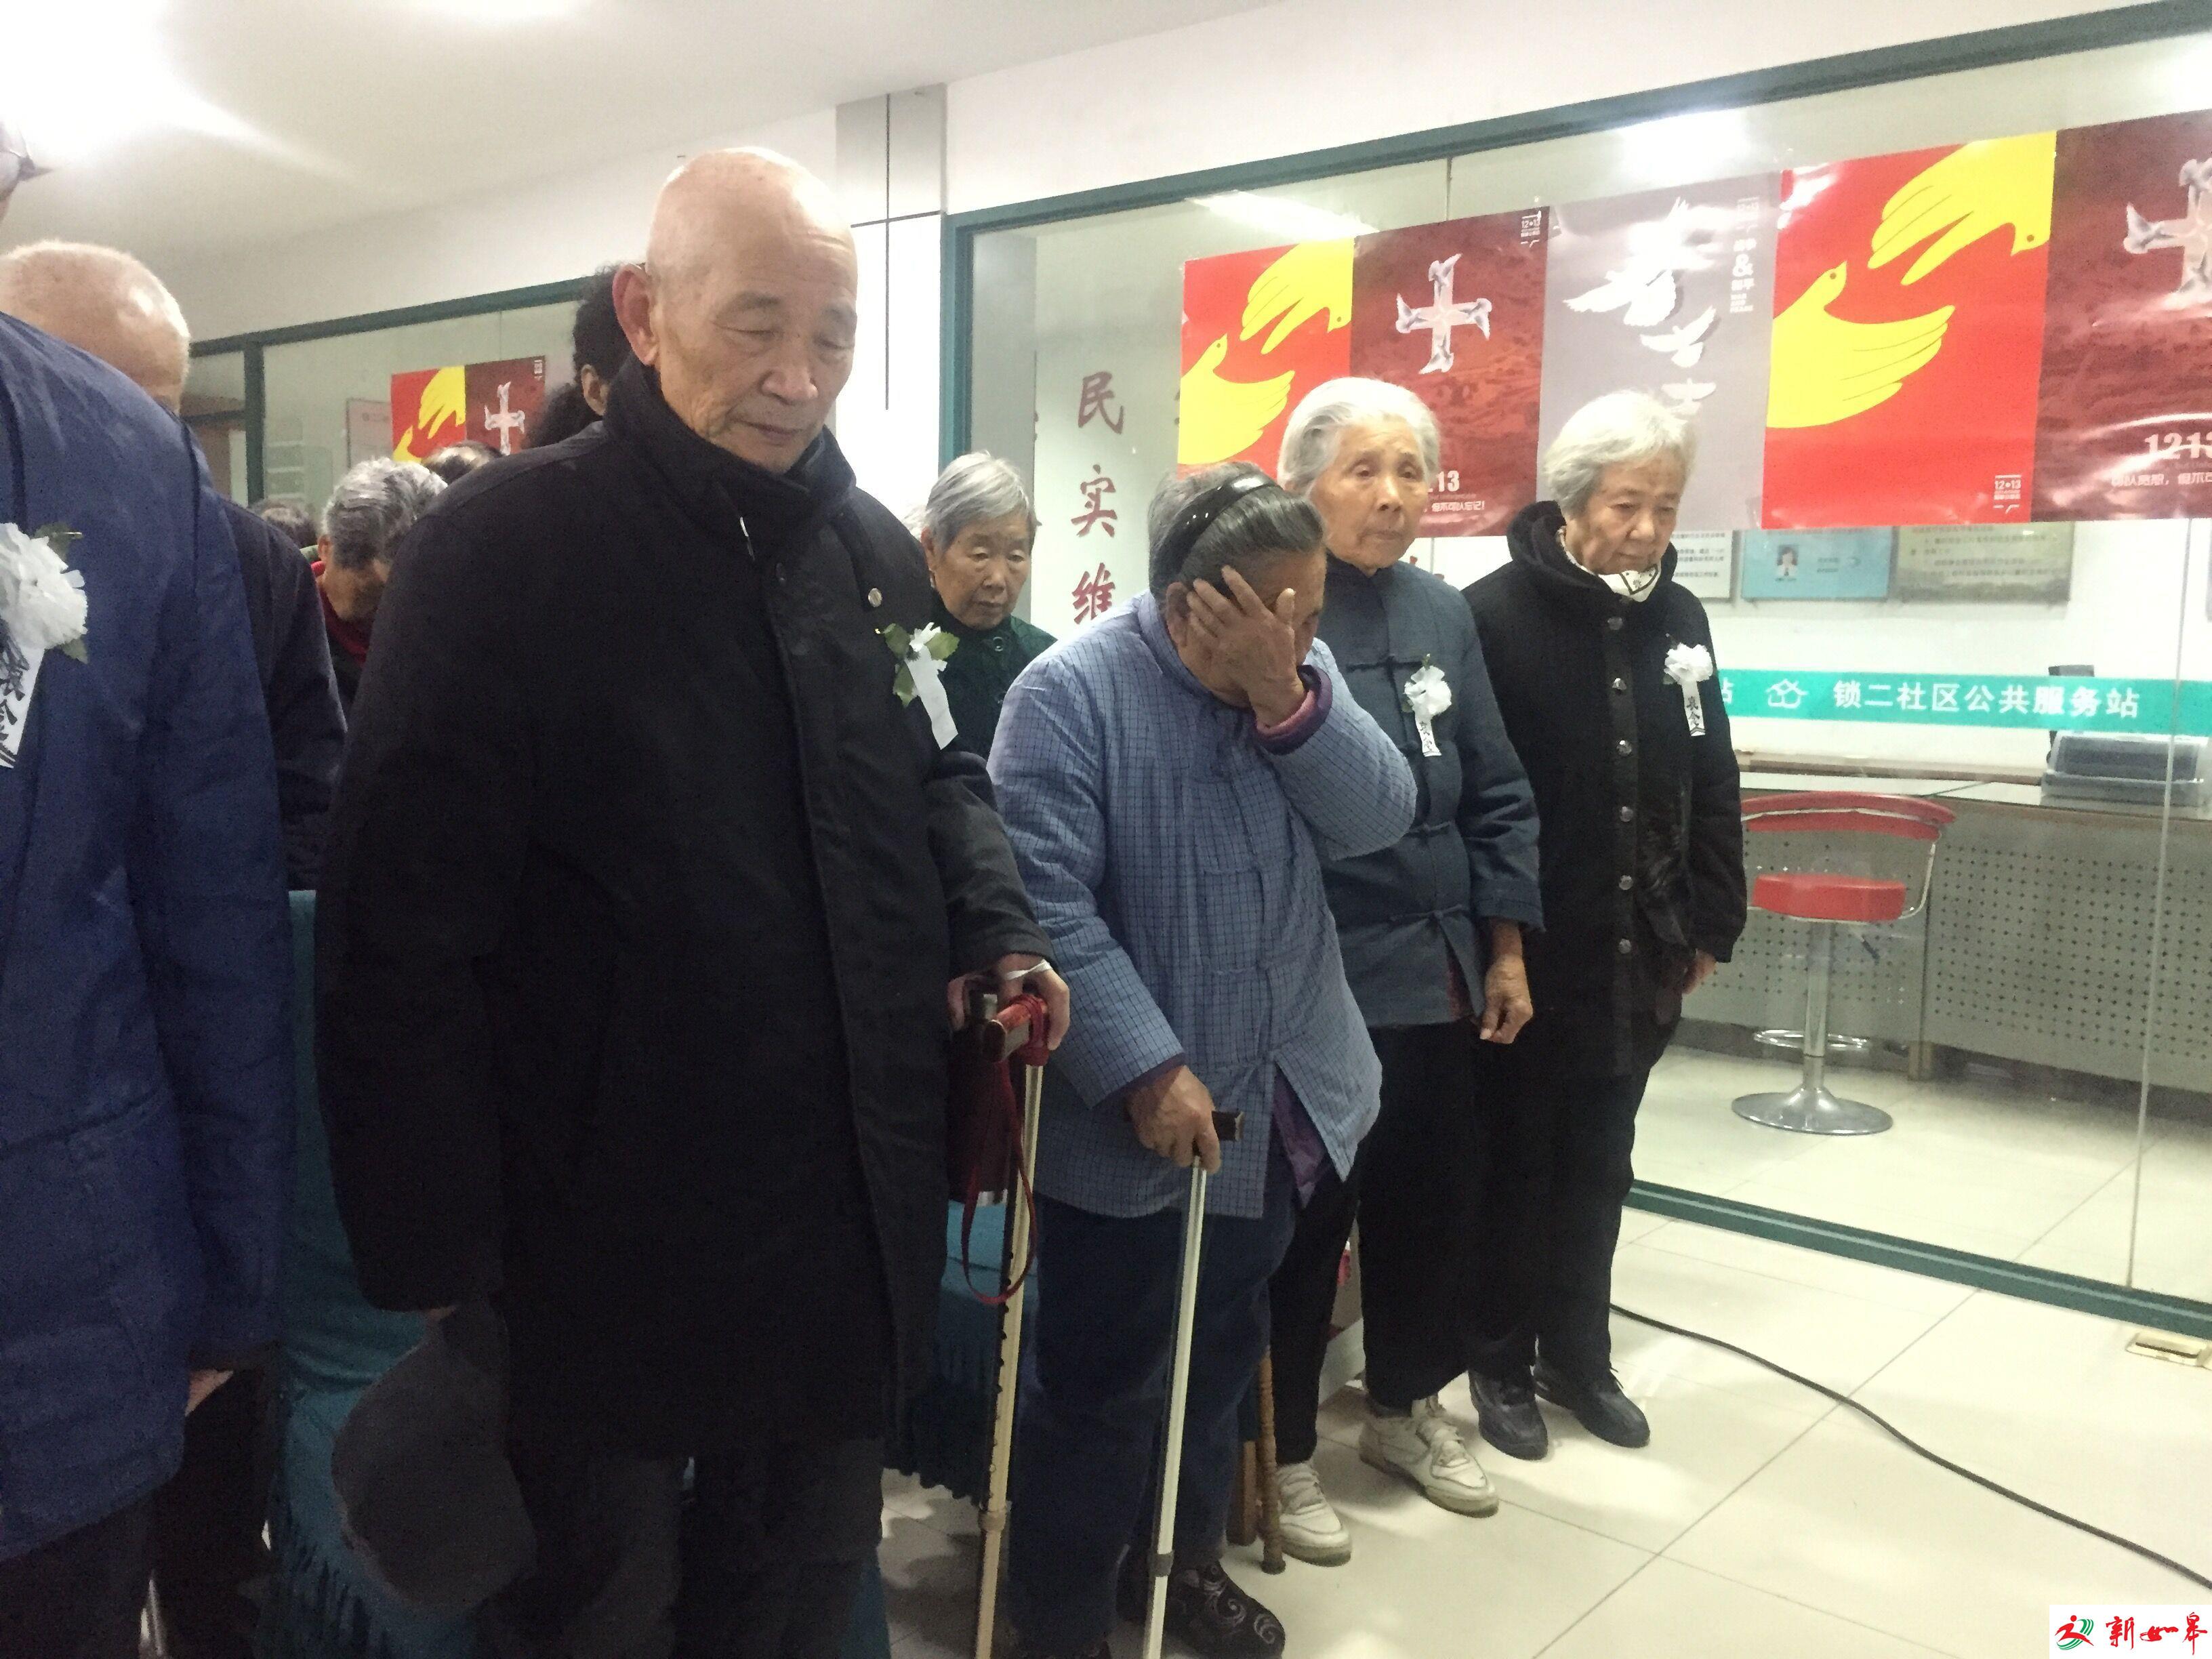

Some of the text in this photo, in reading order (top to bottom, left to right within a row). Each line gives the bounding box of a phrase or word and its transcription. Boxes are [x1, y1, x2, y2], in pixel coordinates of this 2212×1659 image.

[1732, 253, 1754, 277] &
[1832, 680, 2140, 718] 锁二社区公共服务站
